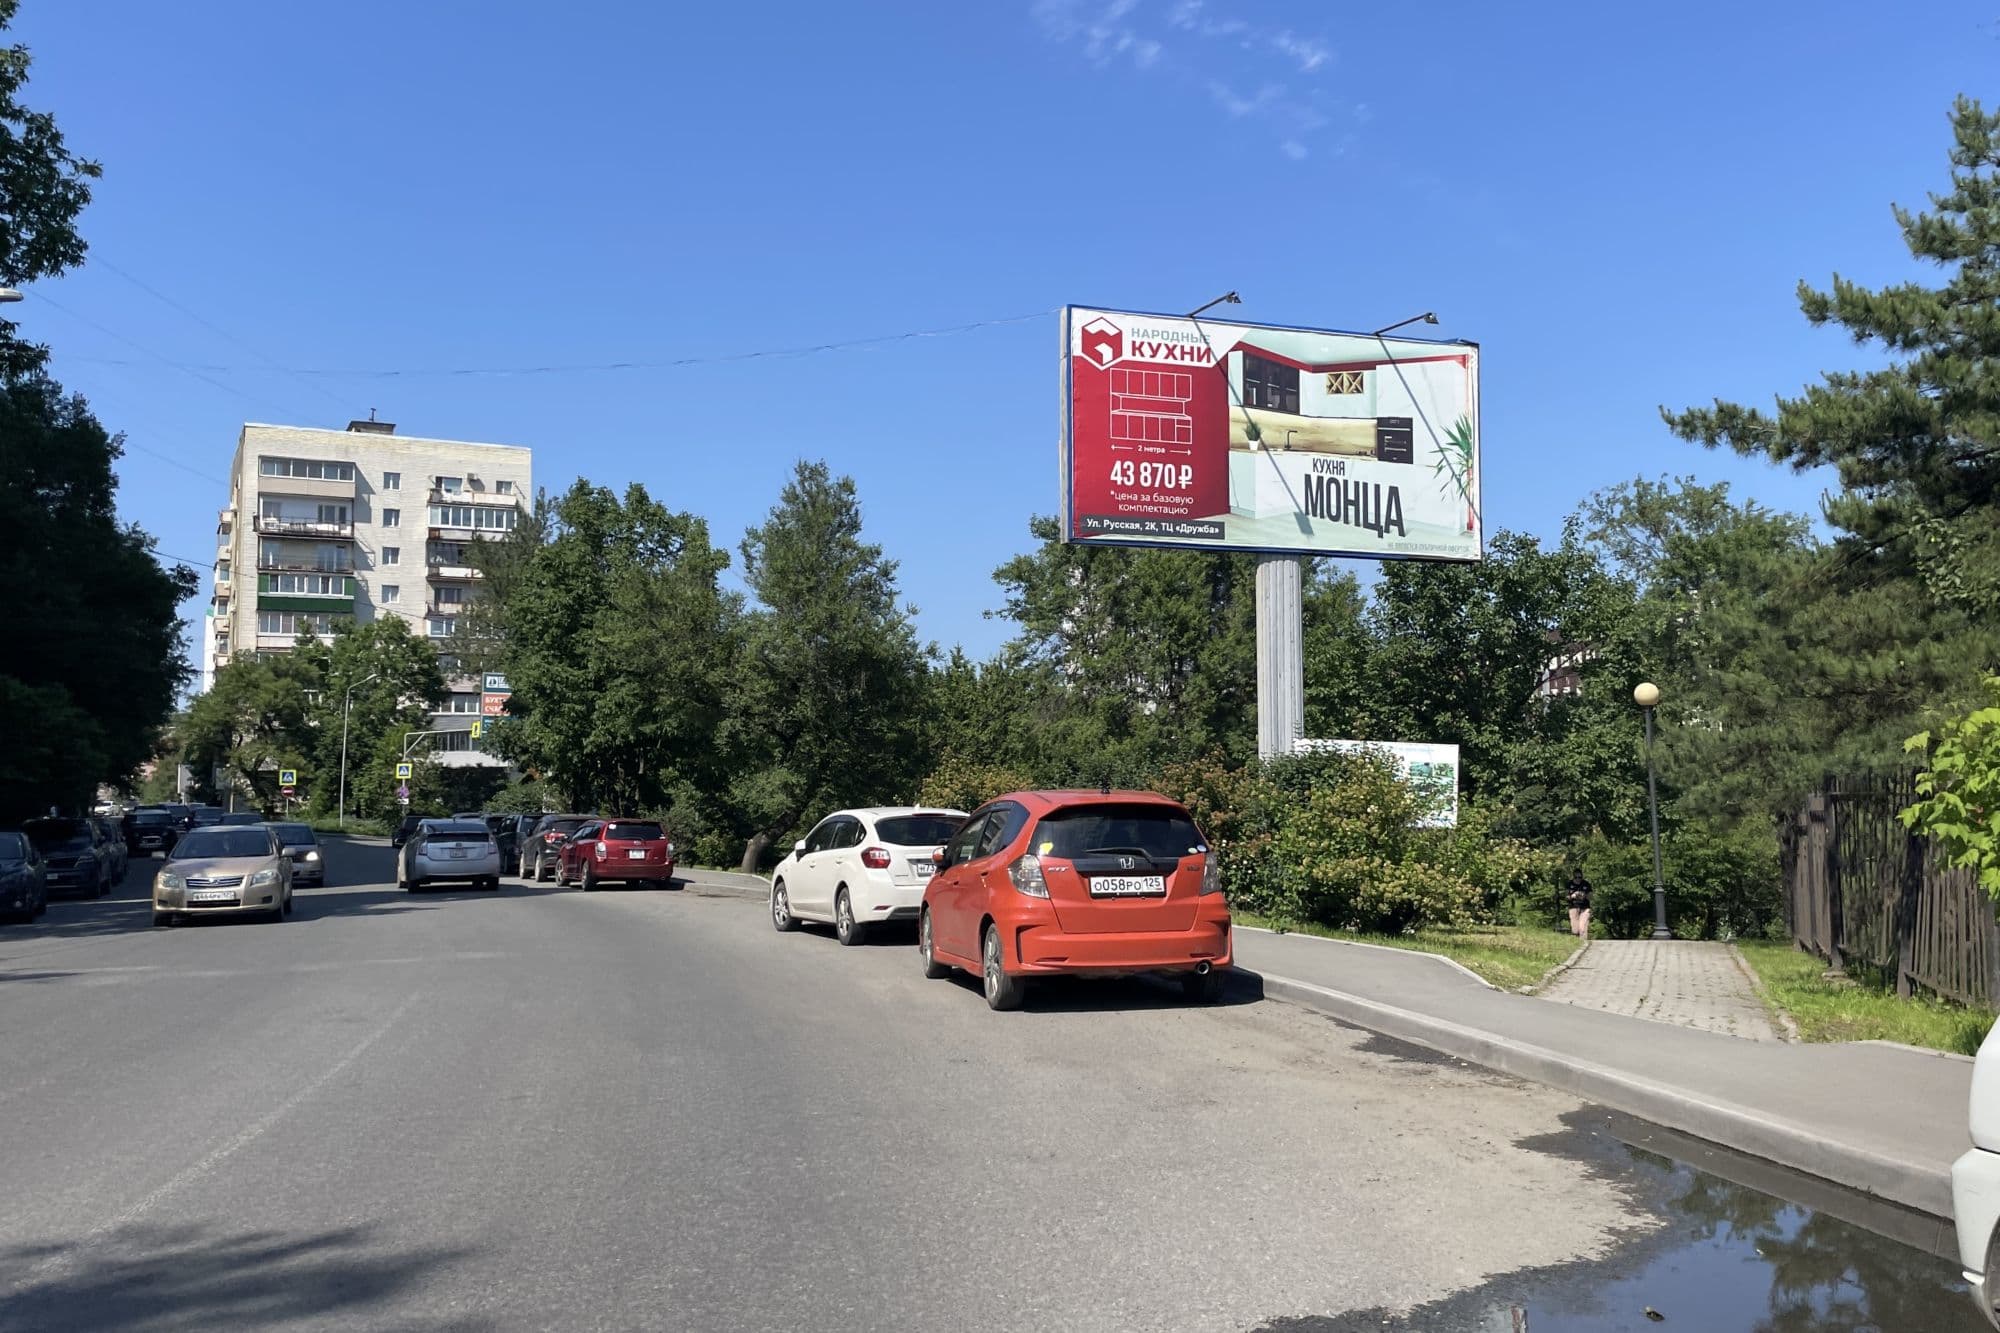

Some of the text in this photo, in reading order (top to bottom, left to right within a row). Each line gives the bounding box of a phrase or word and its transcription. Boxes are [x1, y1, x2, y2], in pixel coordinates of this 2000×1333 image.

[1131, 327, 1211, 343] НАРОДНЫЕ
[1131, 340, 1211, 363] КУХНИ
[1144, 446, 1166, 455] метра
[1110, 460, 1135, 486] 43
[1312, 457, 1346, 477] КУХНЯ
[1140, 494, 1151, 502] за
[1153, 492, 1194, 507] базовую
[1304, 473, 1406, 539] МОНЦА
[1118, 503, 1188, 515] комплектацию
[1086, 518, 1220, 535] Ул. Русская, 2К, ТЦ «Дружба»
[1143, 878, 1161, 887] 125
